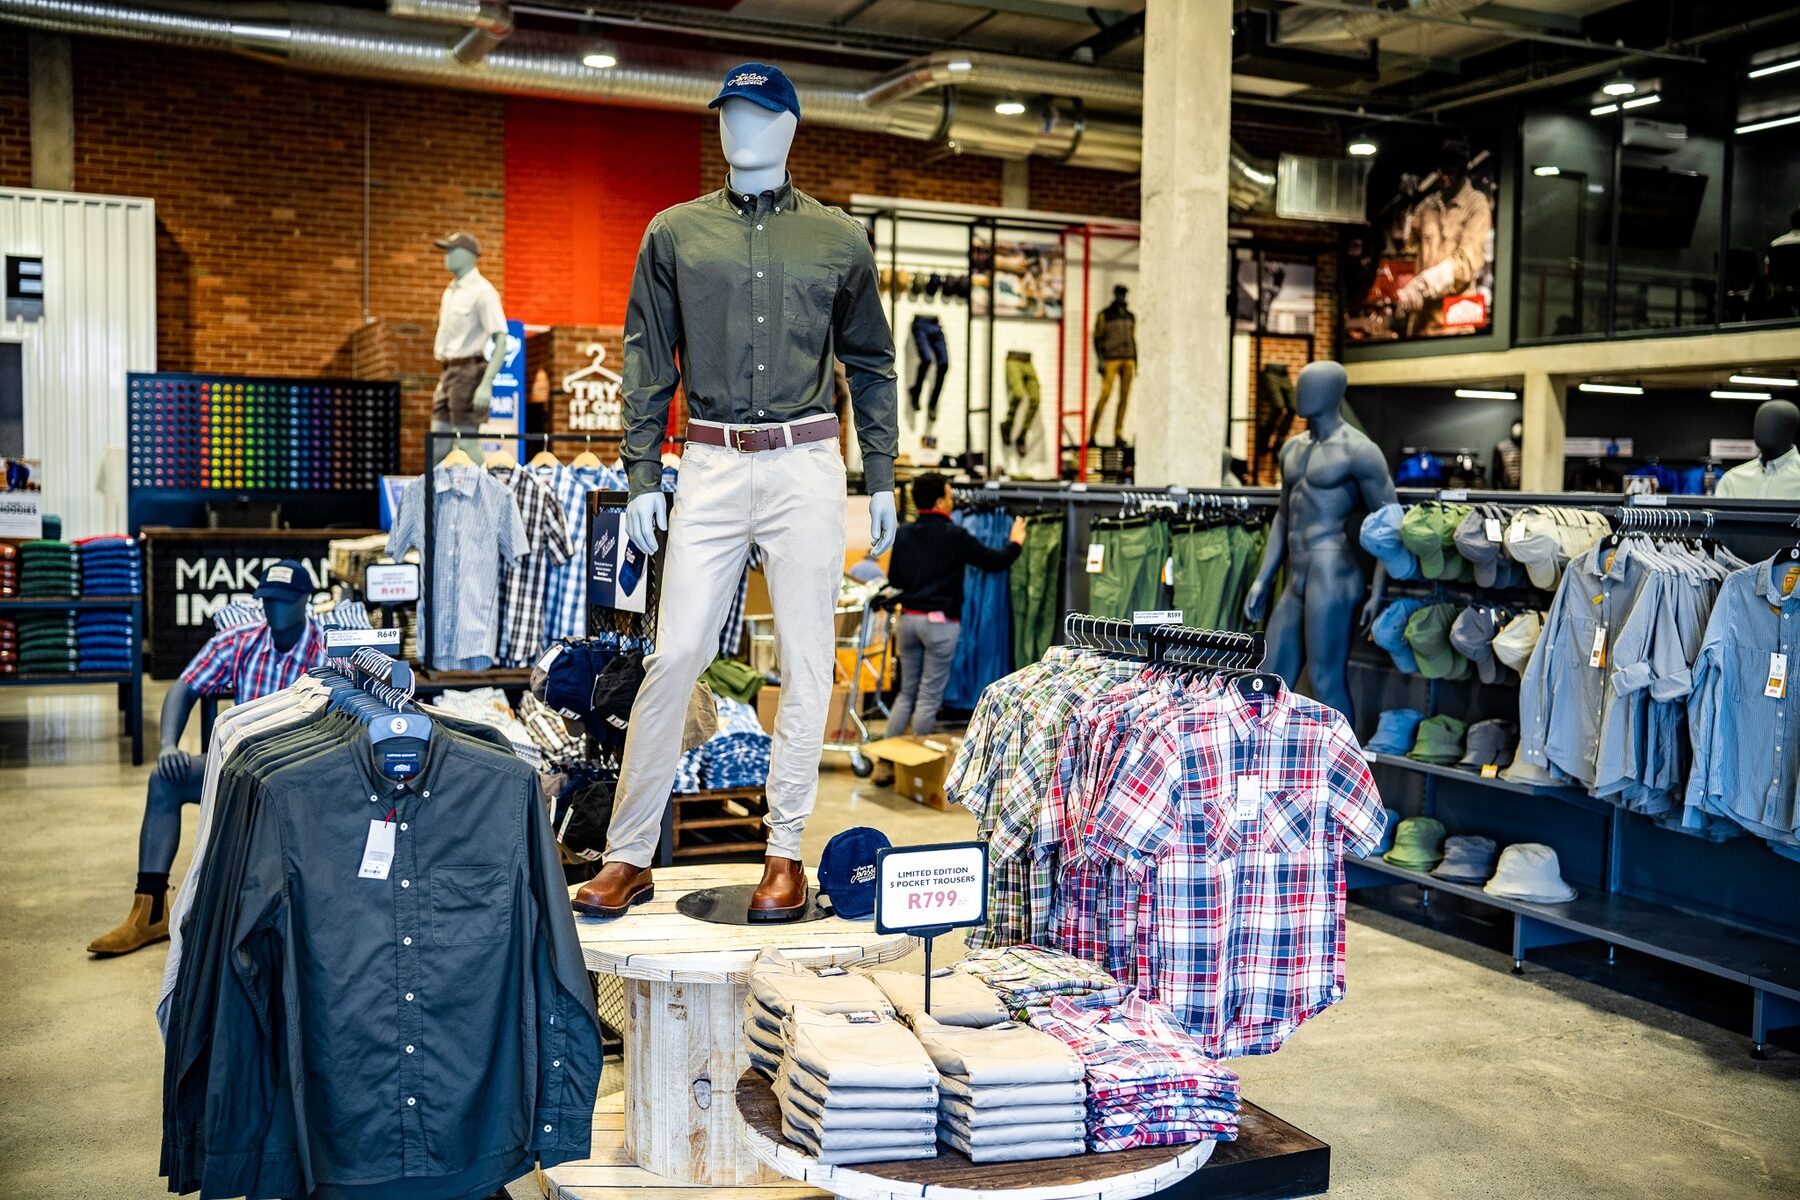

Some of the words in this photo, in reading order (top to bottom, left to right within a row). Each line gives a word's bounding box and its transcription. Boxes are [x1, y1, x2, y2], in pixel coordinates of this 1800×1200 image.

[6, 255, 43, 299] E
[571, 381, 620, 401] TRY
[569, 399, 589, 414] IT
[592, 400, 622, 415] ON
[377, 630, 397, 638] R649
[1255, 680, 1260, 688] S
[396, 721, 402, 730] S
[898, 869, 932, 878] LIMITED
[933, 867, 969, 876] EDITION
[896, 879, 931, 888] POCKET
[933, 875, 976, 885] TROUSERS
[908, 890, 957, 910] R799
